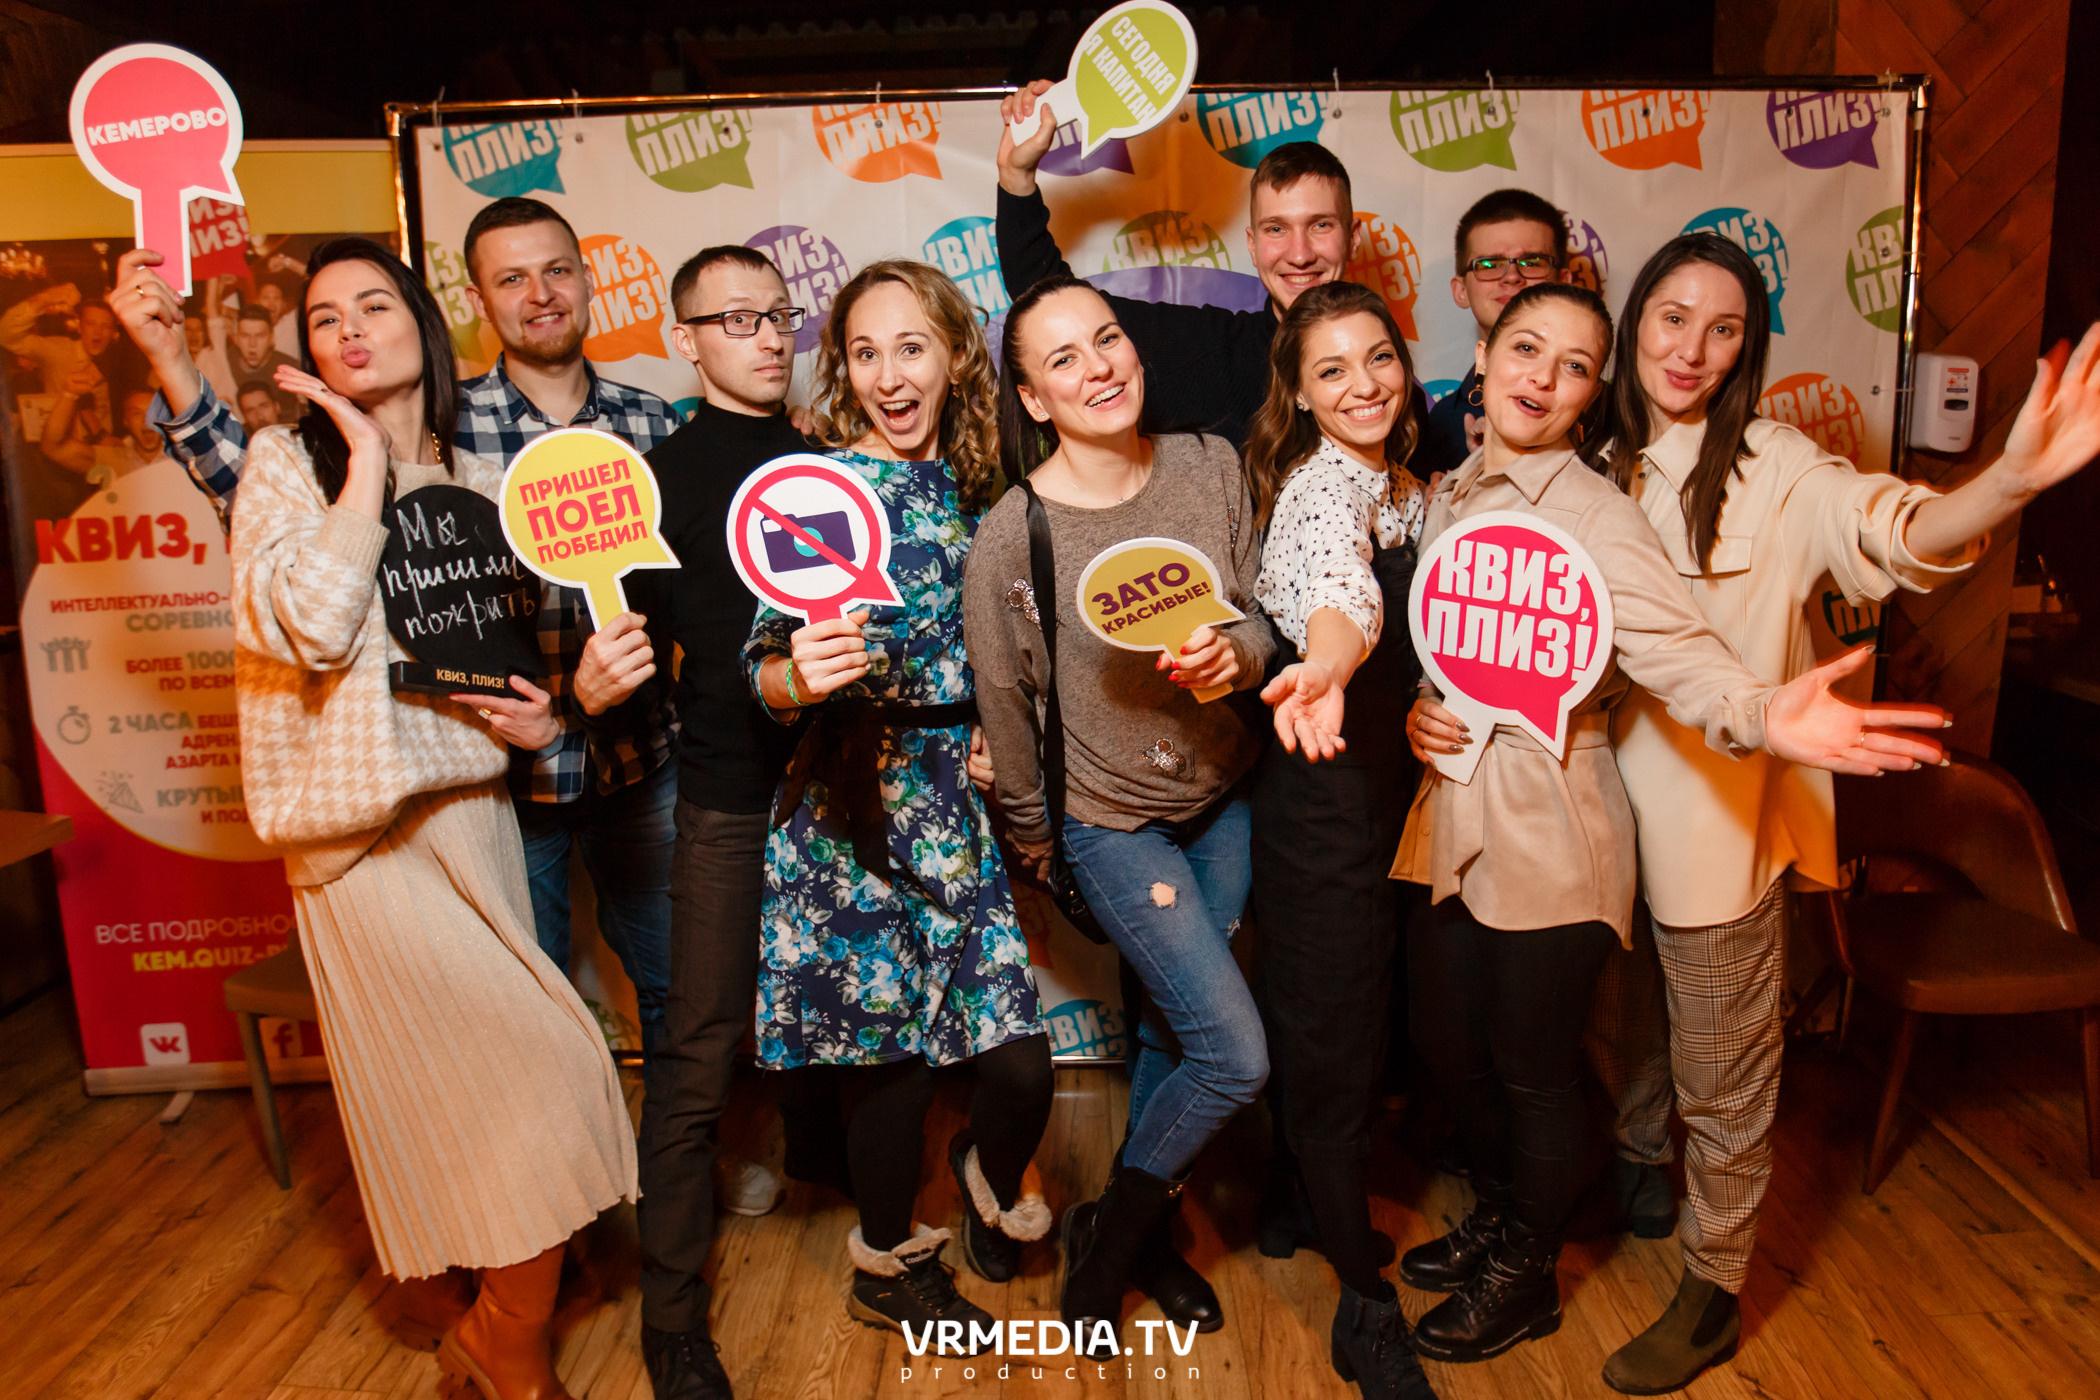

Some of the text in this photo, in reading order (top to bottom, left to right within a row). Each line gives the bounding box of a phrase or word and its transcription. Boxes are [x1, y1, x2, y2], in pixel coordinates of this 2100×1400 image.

[1083, 33, 1158, 123] Я КАПИТАН
[1111, 16, 1177, 96] СЕГОДНЯ
[86, 106, 227, 146] КЕМЕРОВО
[1851, 218, 1904, 273] КВ
[519, 458, 631, 506] ПРИШЕЛ
[396, 502, 468, 551] Мы
[526, 484, 642, 542] ПОЕЛ
[34, 512, 208, 565] КВИЗ,
[537, 520, 648, 564] ПОБЕДИЛ
[1091, 562, 1190, 615] ЗАТО
[1437, 539, 1591, 623] КВИЗ,
[1101, 581, 1212, 634] КРАСИВЫЕ!
[1427, 597, 1593, 682] ПЛИЗ!
[126, 656, 184, 674] БОЛЕЕ
[159, 676, 186, 692] ПО
[436, 668, 505, 689] КВИЗ, ПЛИЗ!
[108, 715, 122, 734] 2
[126, 711, 193, 732] ЧАСА
[165, 753, 231, 770] АЗАРТА
[95, 922, 144, 945] ВСЕ
